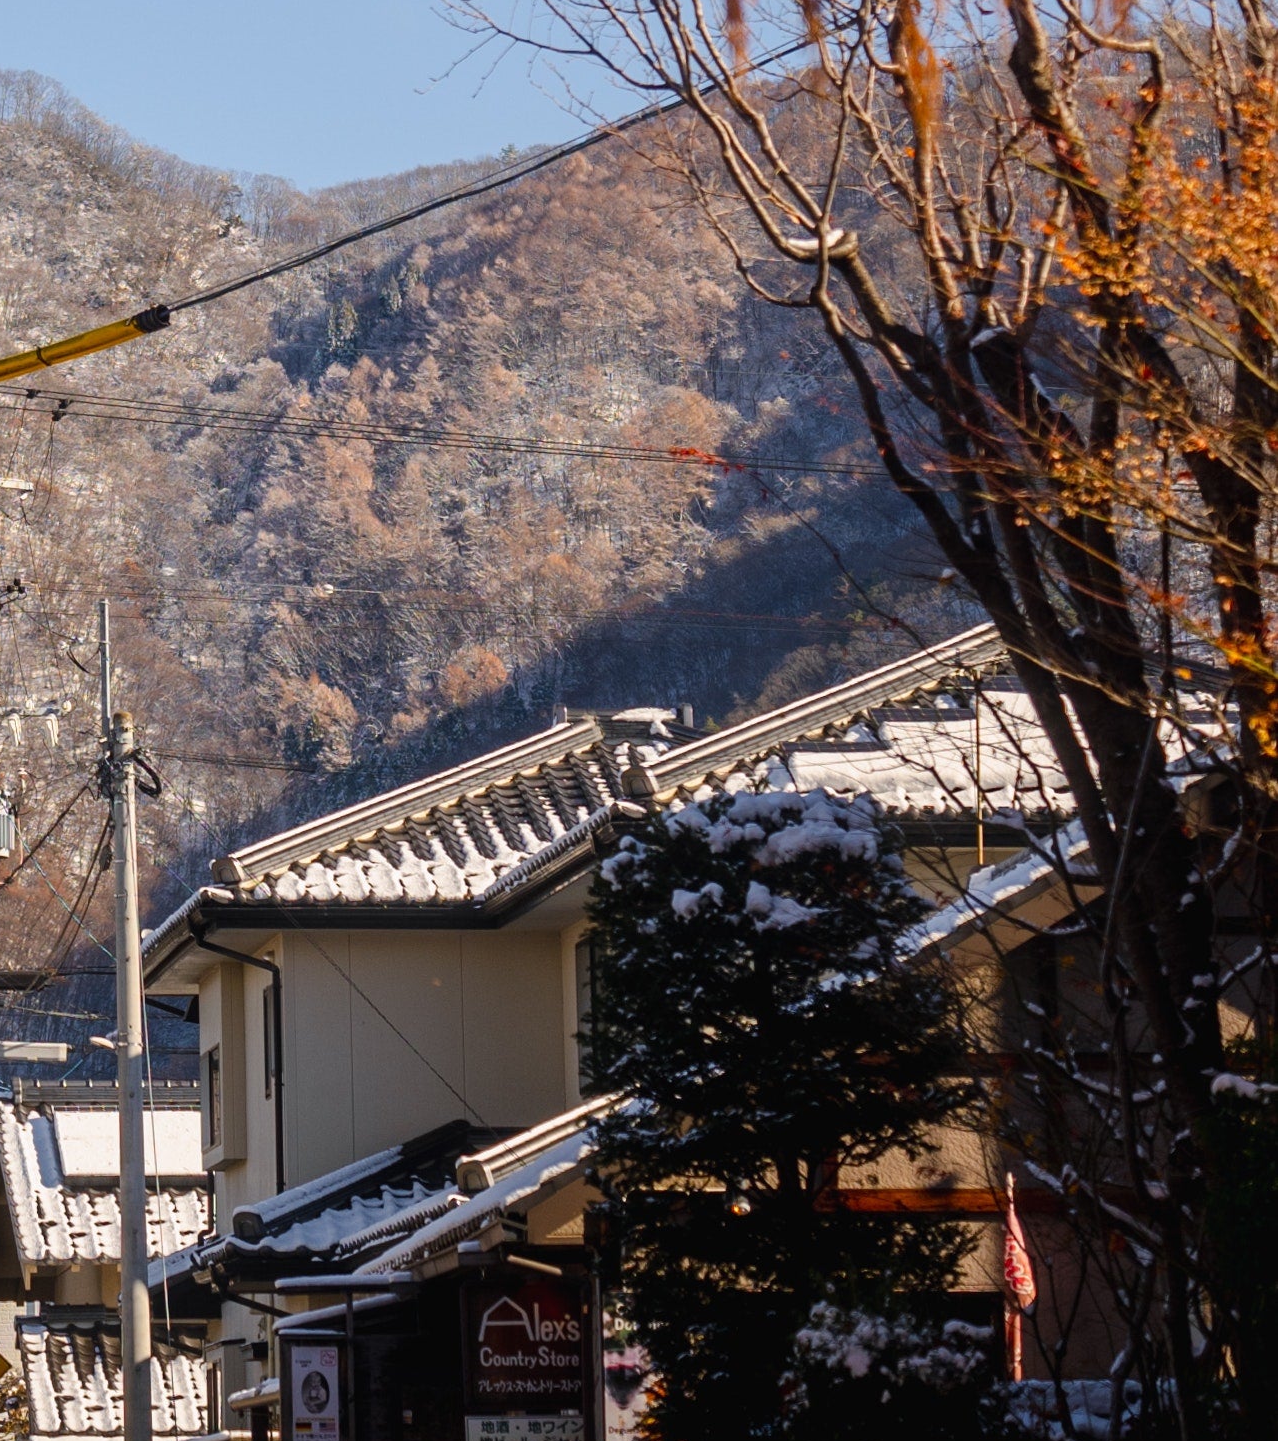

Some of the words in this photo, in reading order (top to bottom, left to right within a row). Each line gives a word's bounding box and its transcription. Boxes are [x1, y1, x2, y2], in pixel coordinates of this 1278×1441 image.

[478, 1296, 581, 1342] Alex's
[479, 1346, 537, 1369] Country
[538, 1345, 580, 1367] Store
